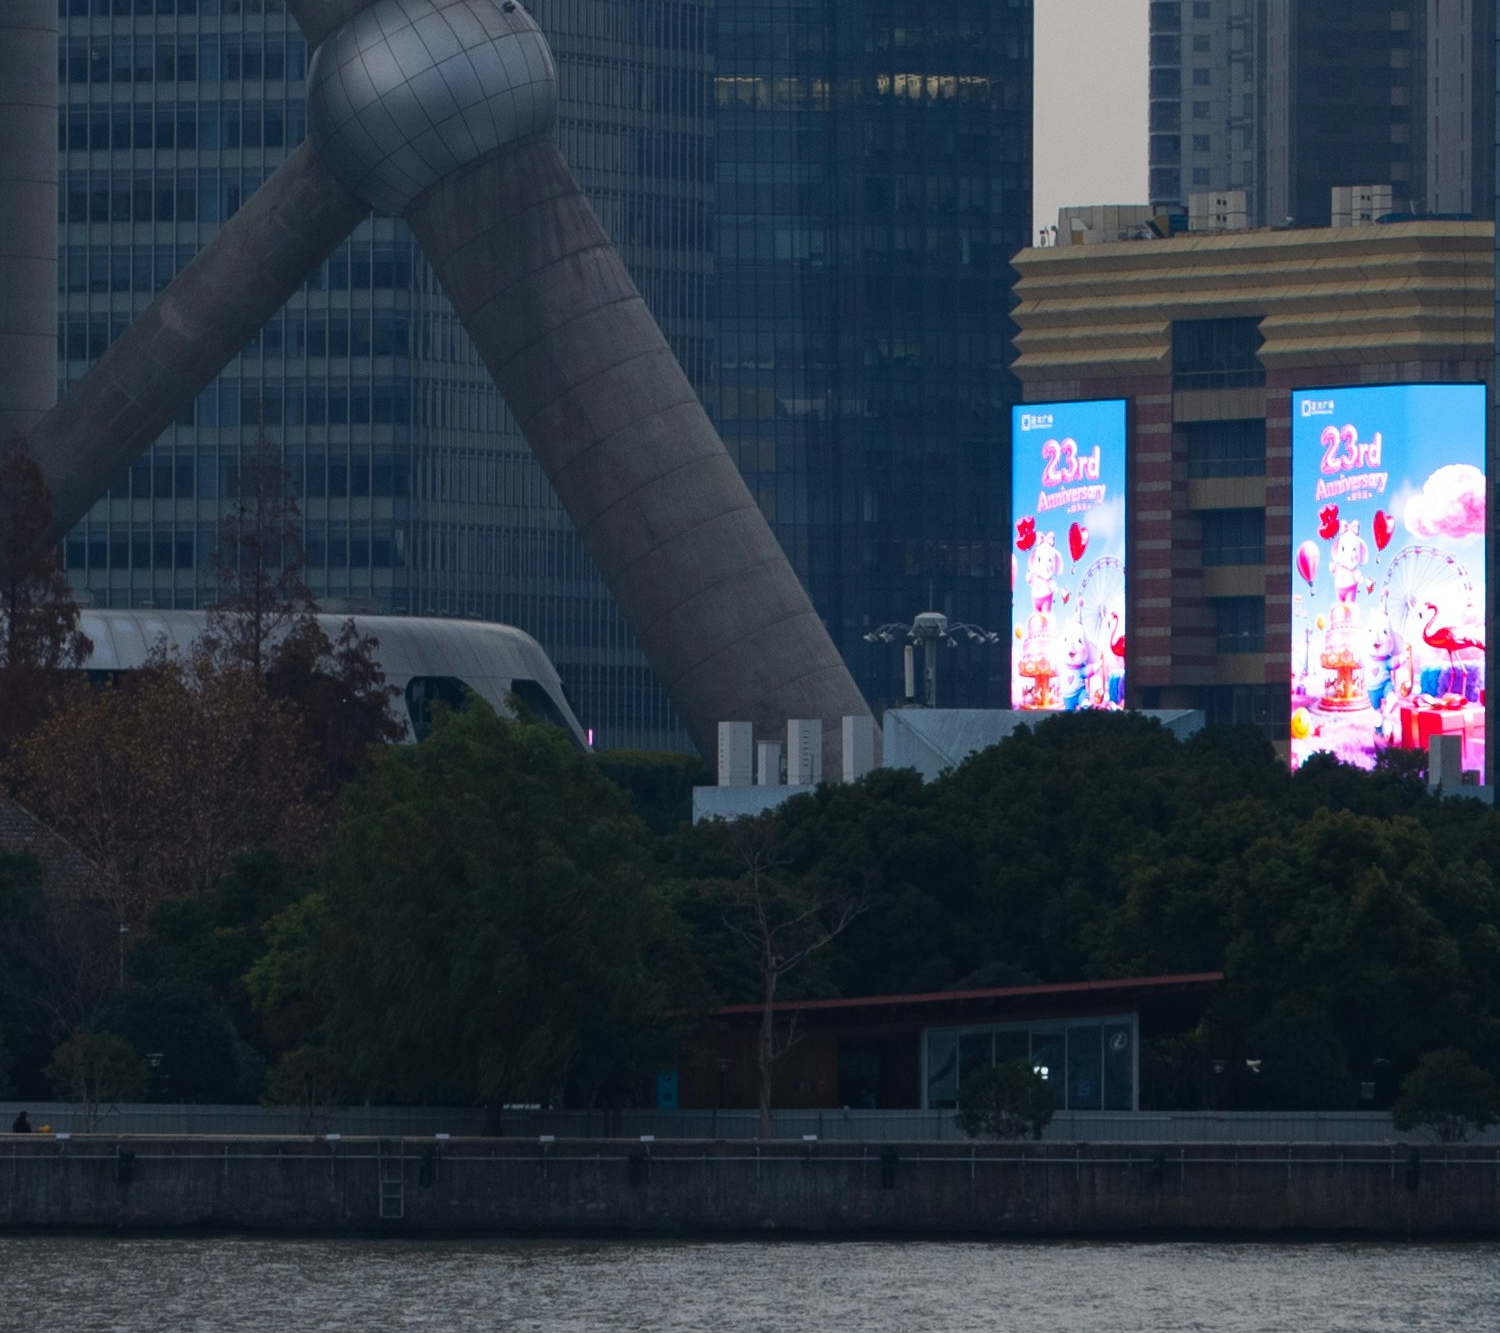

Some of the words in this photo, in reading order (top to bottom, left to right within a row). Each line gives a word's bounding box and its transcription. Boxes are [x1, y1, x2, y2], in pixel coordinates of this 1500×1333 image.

[1041, 437, 1101, 487] 23rd
[1320, 423, 1382, 475] 23rd
[1036, 484, 1106, 513] Anniversary
[1315, 472, 1388, 501] Anniversary
